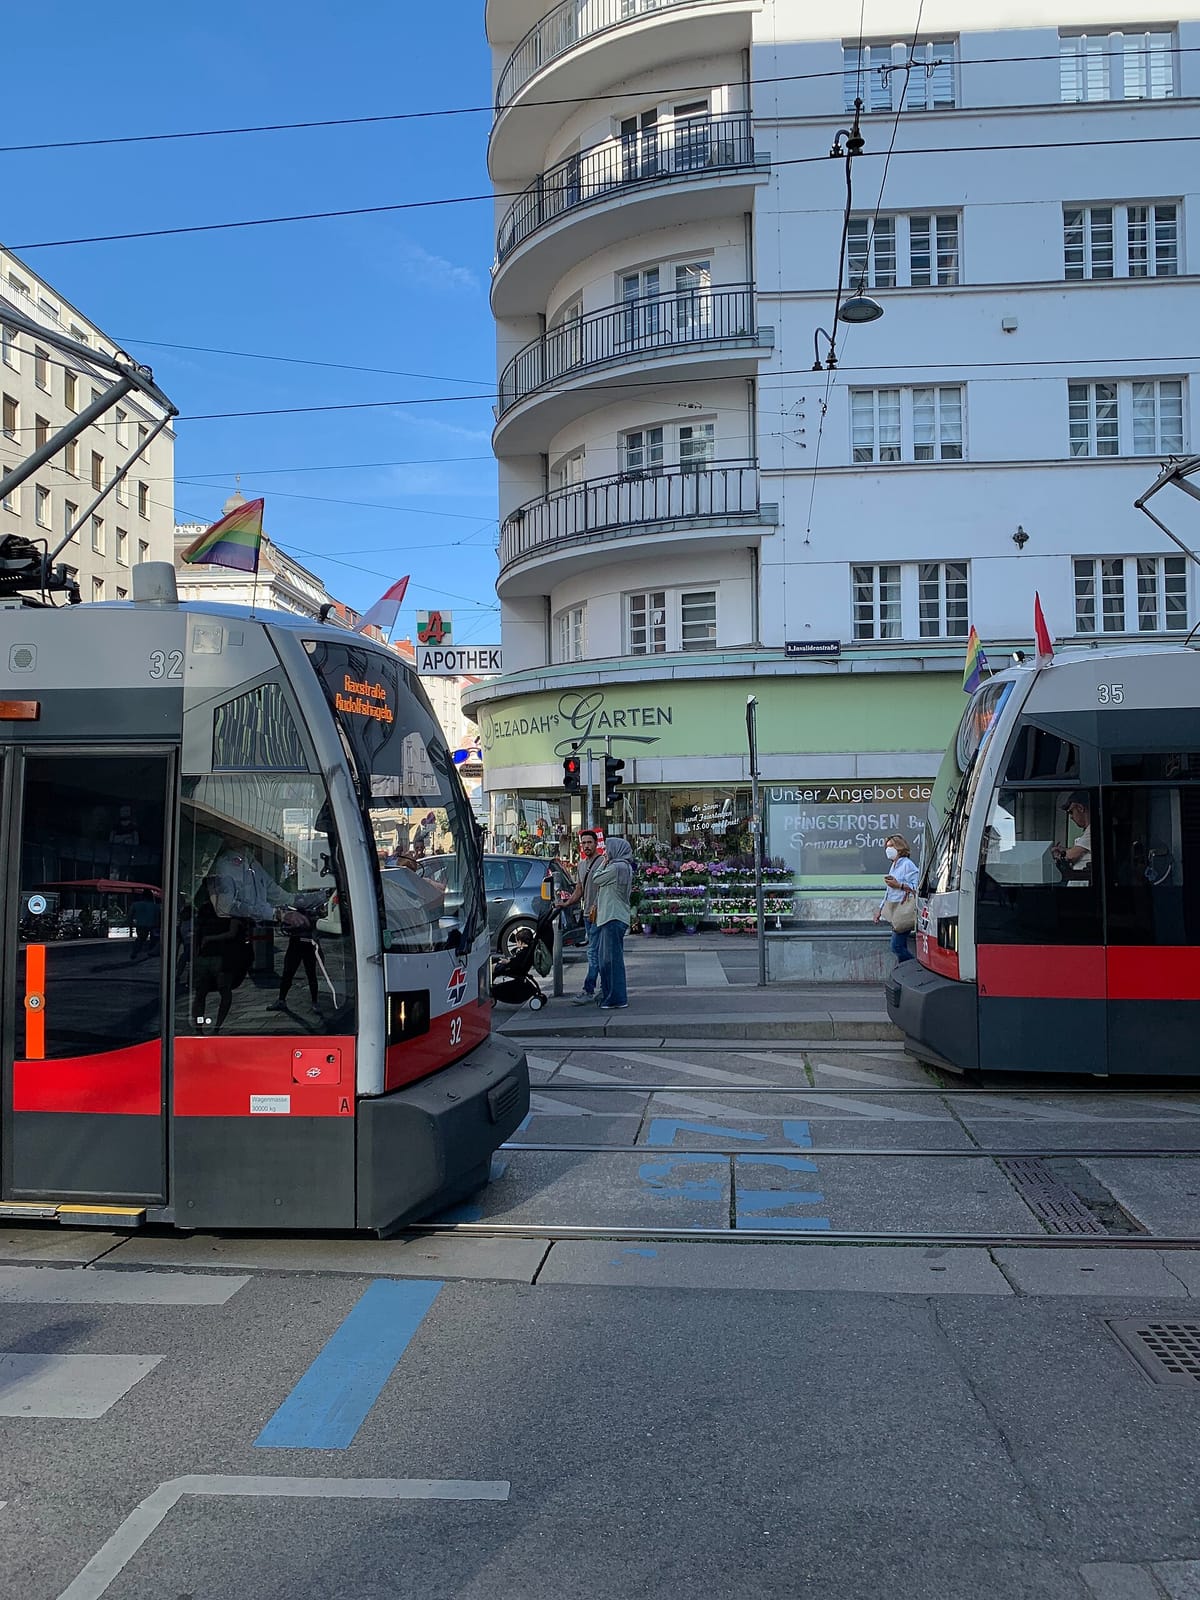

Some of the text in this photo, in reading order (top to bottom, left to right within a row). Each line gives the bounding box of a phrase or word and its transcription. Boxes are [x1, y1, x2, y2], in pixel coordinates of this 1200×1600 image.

[149, 649, 184, 679] 32
[422, 650, 503, 670] APOTHEK
[344, 674, 386, 699] Raxstraße
[1097, 684, 1124, 704] 35
[554, 692, 673, 757] GARTEN
[771, 786, 821, 801] Unser
[826, 785, 904, 802] Angebot
[980, 984, 987, 994] A
[449, 1015, 462, 1046] 32
[340, 1098, 350, 1113] A
